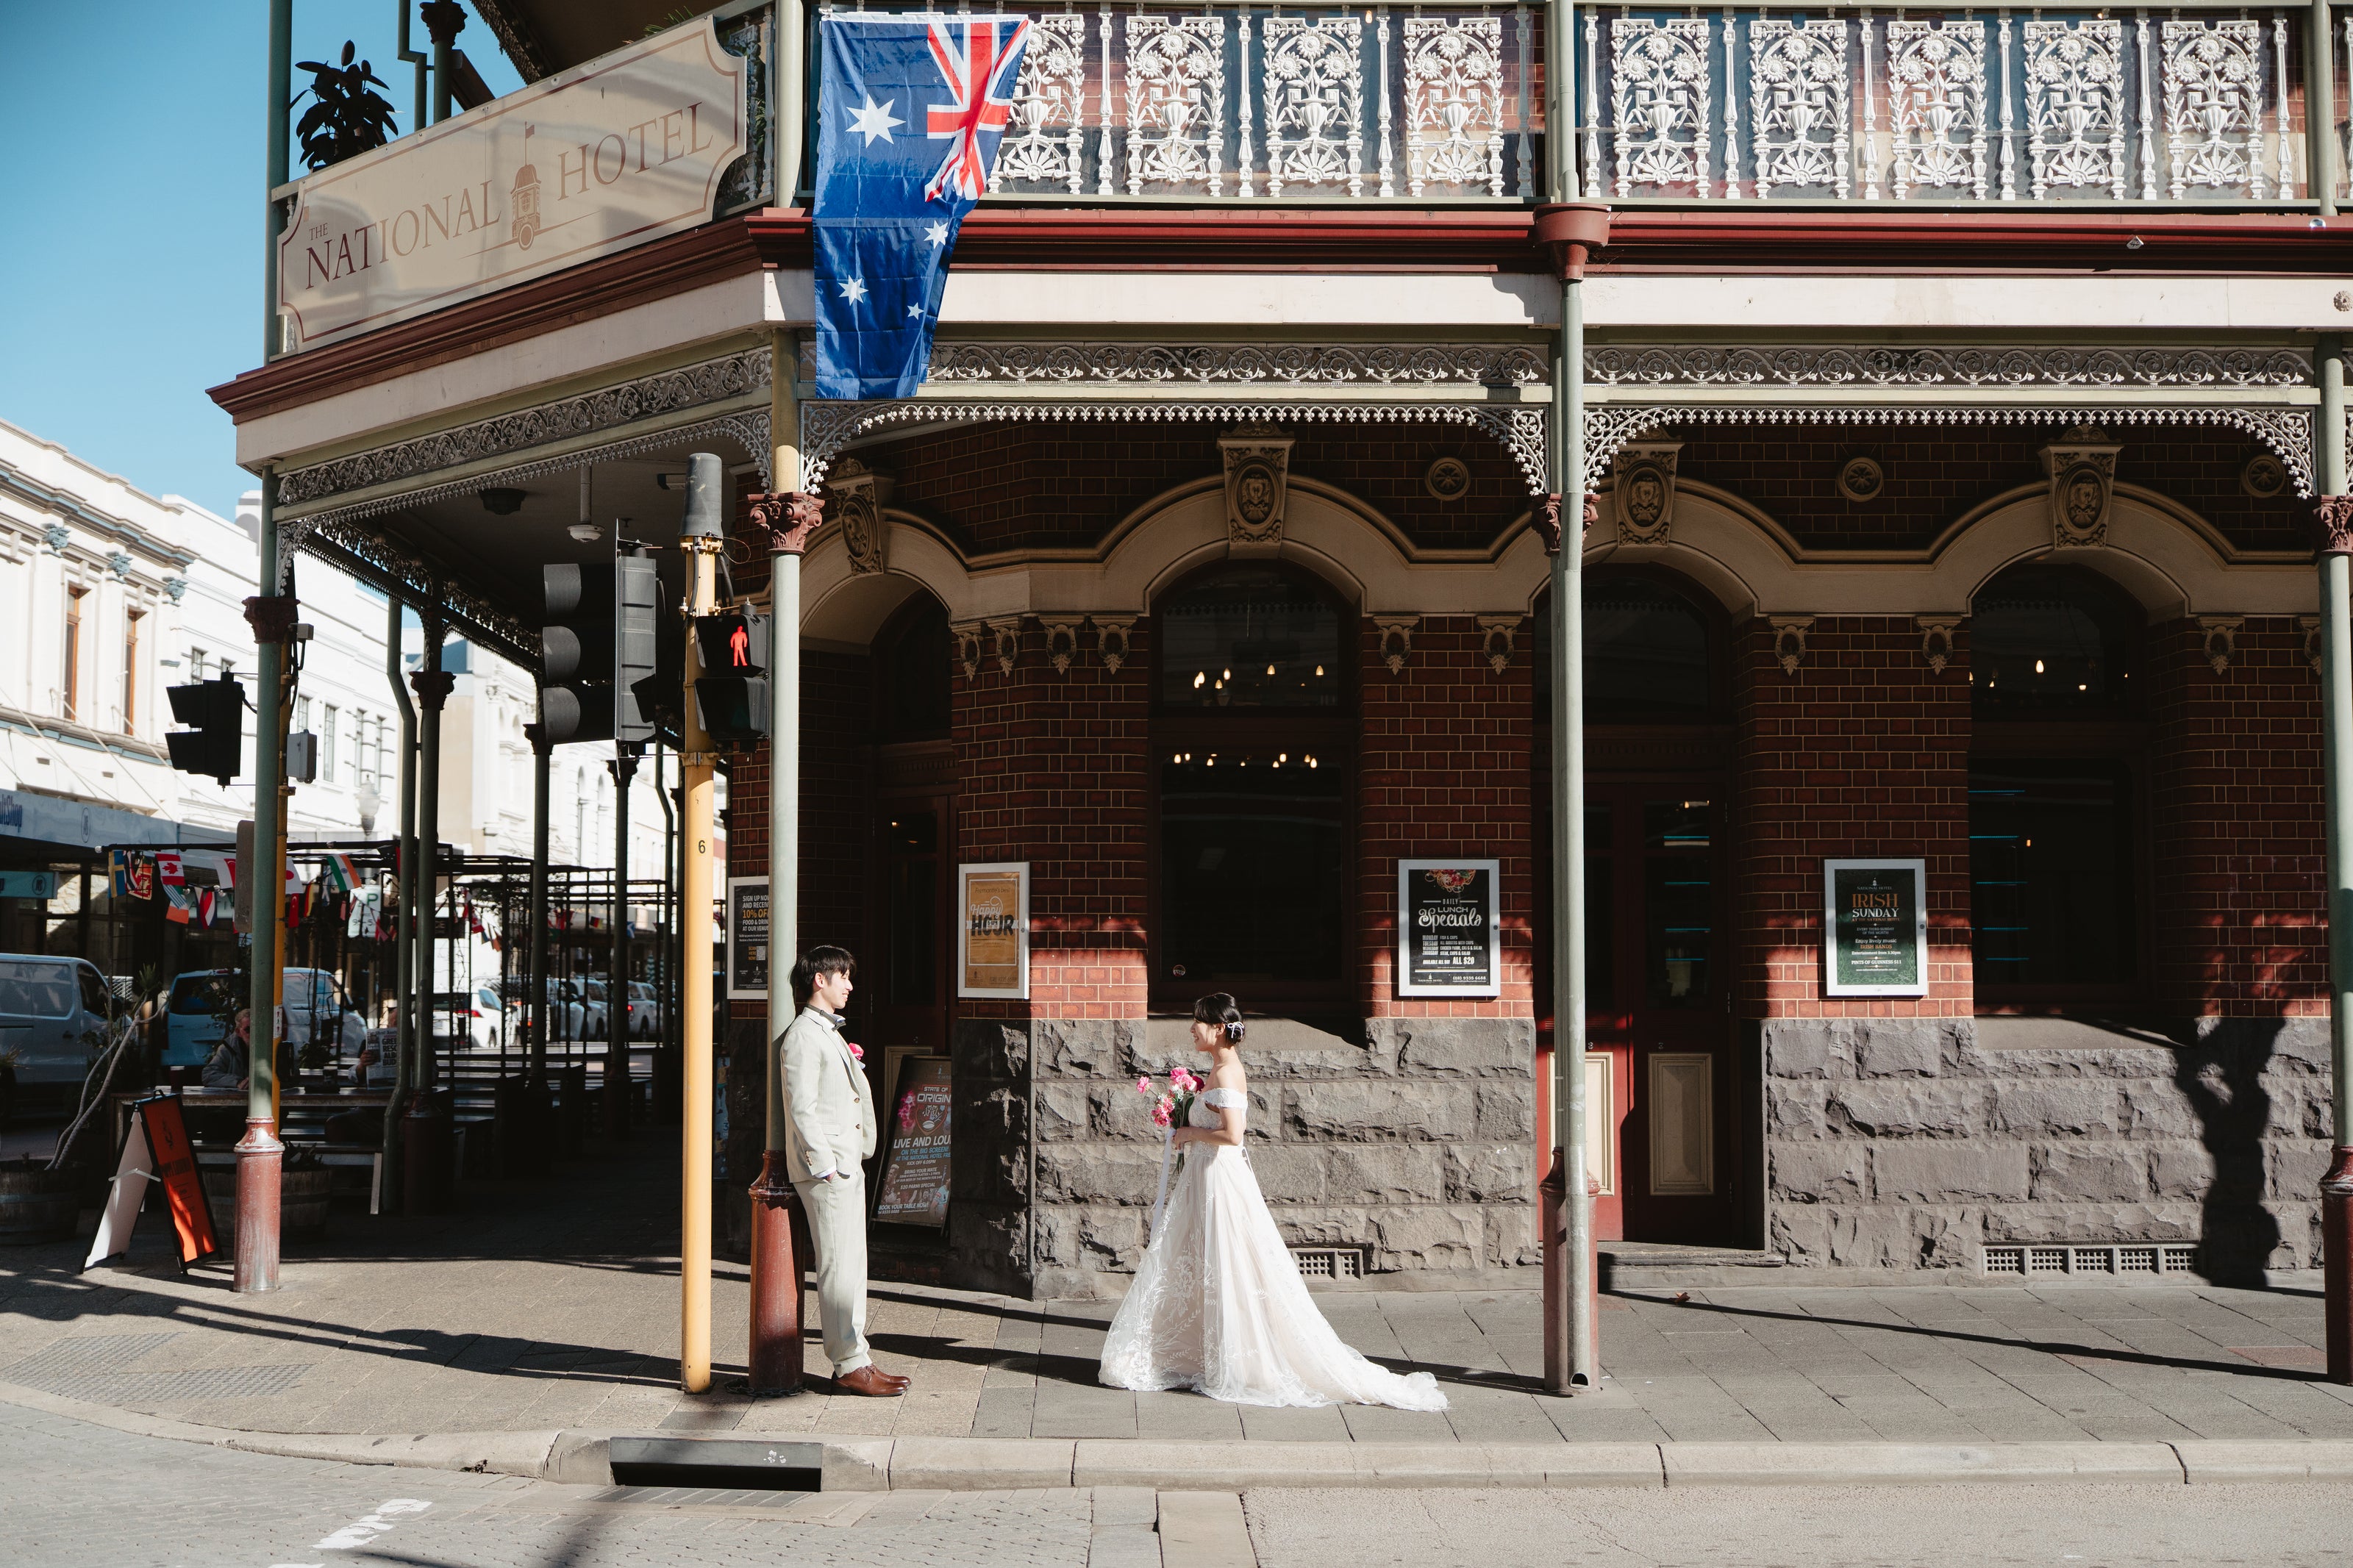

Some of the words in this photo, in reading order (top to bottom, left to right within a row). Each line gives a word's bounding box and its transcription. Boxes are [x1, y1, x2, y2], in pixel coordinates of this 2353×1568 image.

[305, 180, 501, 290] NATIONAL
[558, 101, 713, 201] HOTEL
[309, 223, 329, 240] THE
[699, 840, 706, 853] 6
[971, 896, 1003, 919] Happy
[1852, 894, 1898, 908] IRISH
[743, 909, 757, 918] 10%
[758, 909, 768, 918] OF
[1852, 908, 1899, 917] SUNDAY
[971, 914, 1014, 936] HOUR
[1418, 907, 1482, 934] Specials
[1452, 956, 1462, 964] ALL
[1463, 956, 1475, 964] $20
[917, 1094, 951, 1103] ORIGIN
[893, 1138, 912, 1148] LIVE
[913, 1136, 932, 1147] AND
[933, 1135, 951, 1145] LOU
